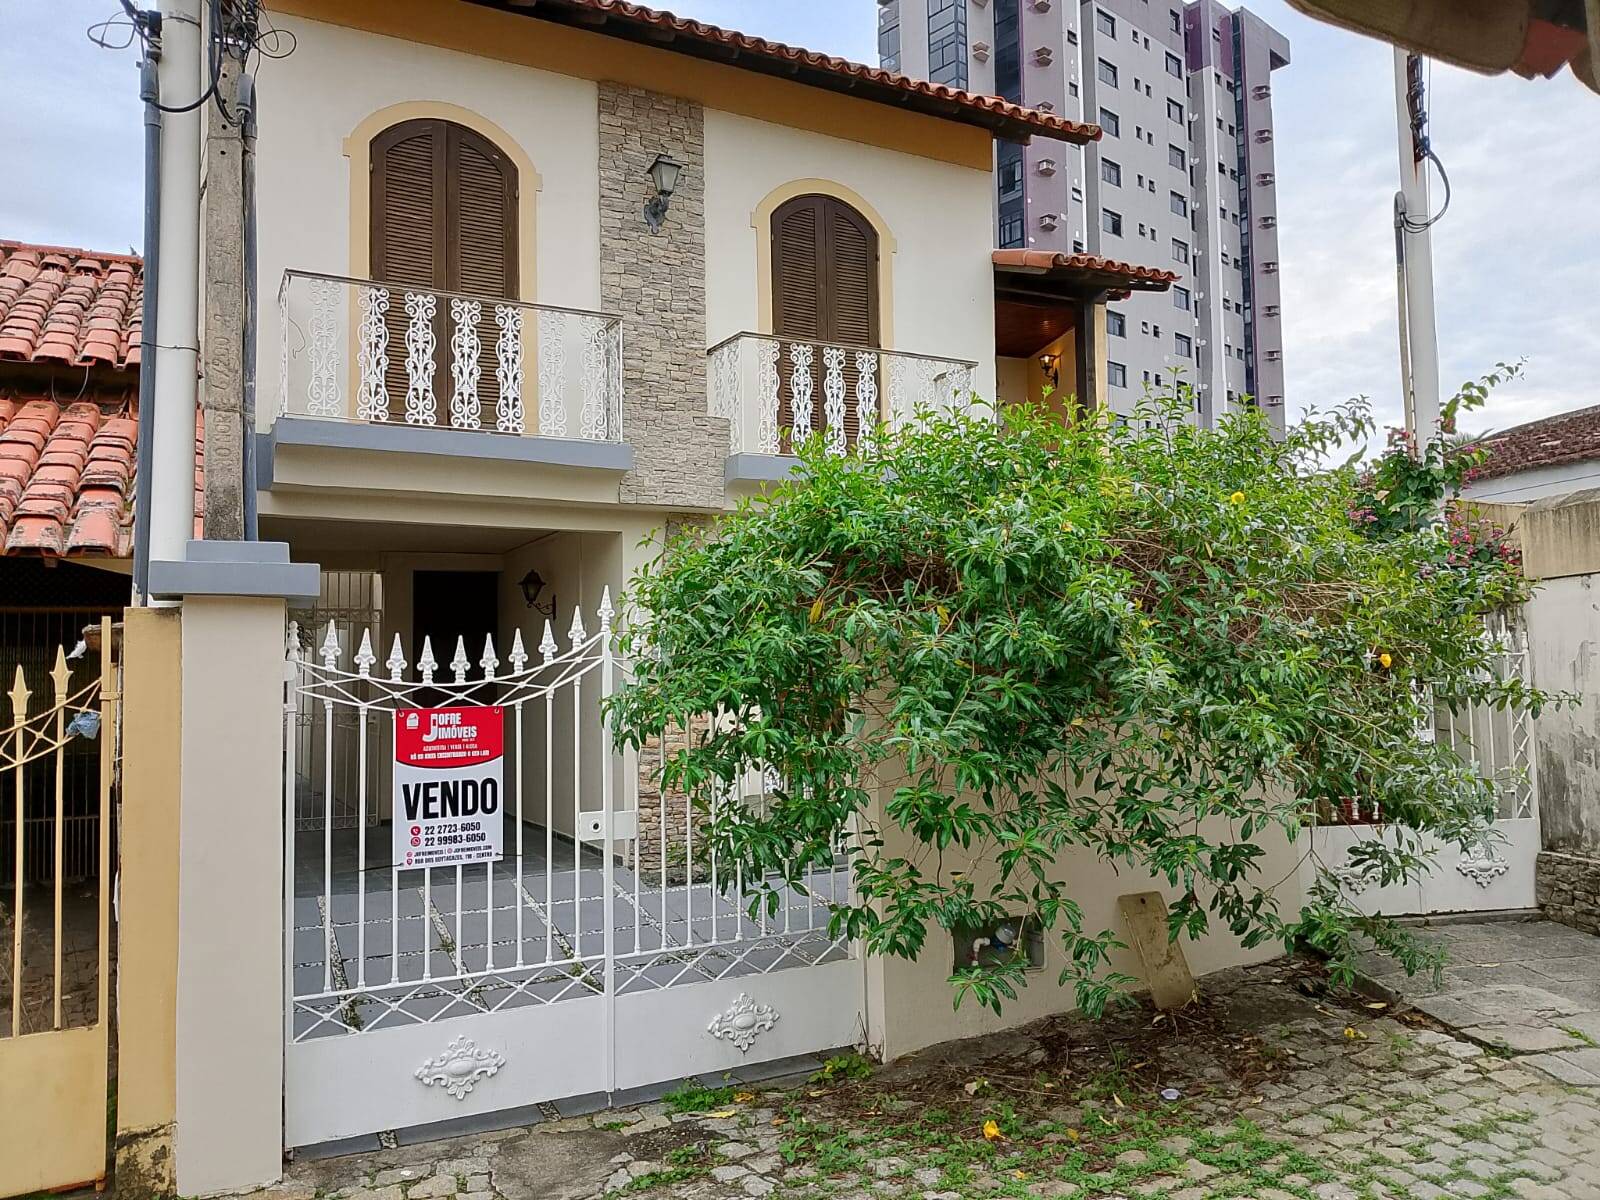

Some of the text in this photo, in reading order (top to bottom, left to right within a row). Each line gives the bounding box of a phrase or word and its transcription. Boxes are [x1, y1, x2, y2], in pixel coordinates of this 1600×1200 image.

[422, 712, 462, 742] JOFRE
[438, 725, 477, 739] IMÓVEIS
[402, 778, 498, 820] VENDO
[424, 822, 481, 835] 22 2723-6050
[424, 832, 486, 847] 22 99983-6050
